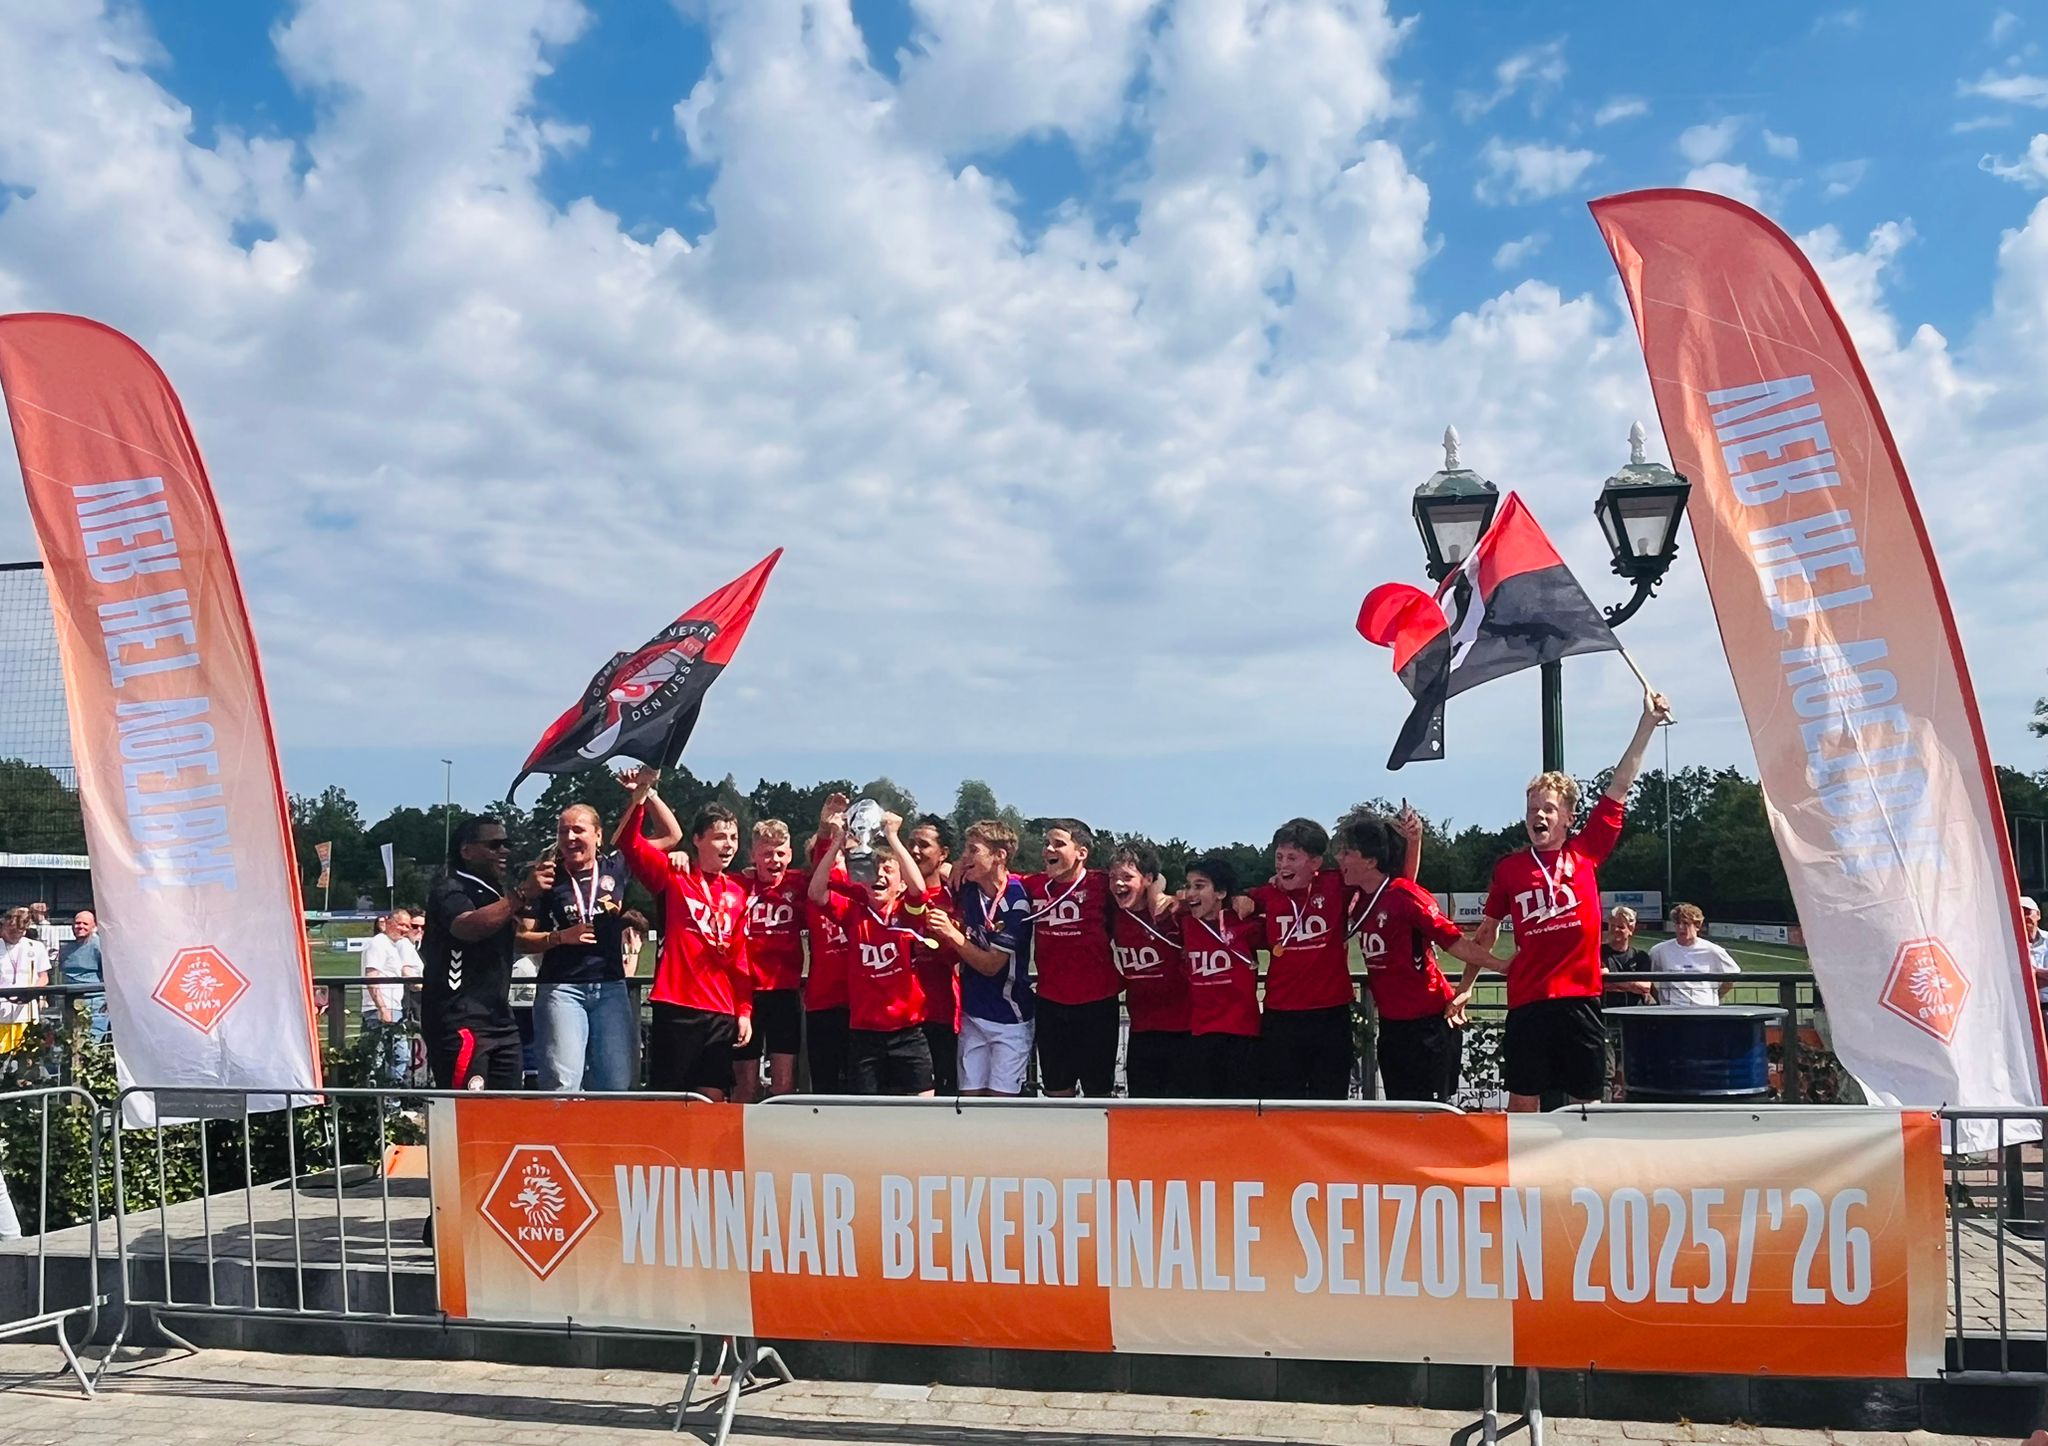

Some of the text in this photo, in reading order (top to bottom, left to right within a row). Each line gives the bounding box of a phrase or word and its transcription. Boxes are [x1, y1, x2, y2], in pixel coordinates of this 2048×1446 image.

[631, 699, 662, 721] DEN
[1514, 882, 1582, 925] TLO
[1276, 915, 1332, 941] TLO
[859, 943, 900, 970] TLO
[1116, 946, 1164, 972] TLO
[1188, 950, 1233, 976] TLO
[518, 1226, 565, 1241] KNVB
[614, 1164, 858, 1279] WINNAAR
[881, 1174, 1267, 1293] BEKERFINALE
[1292, 1182, 1545, 1301] SEIZOEN
